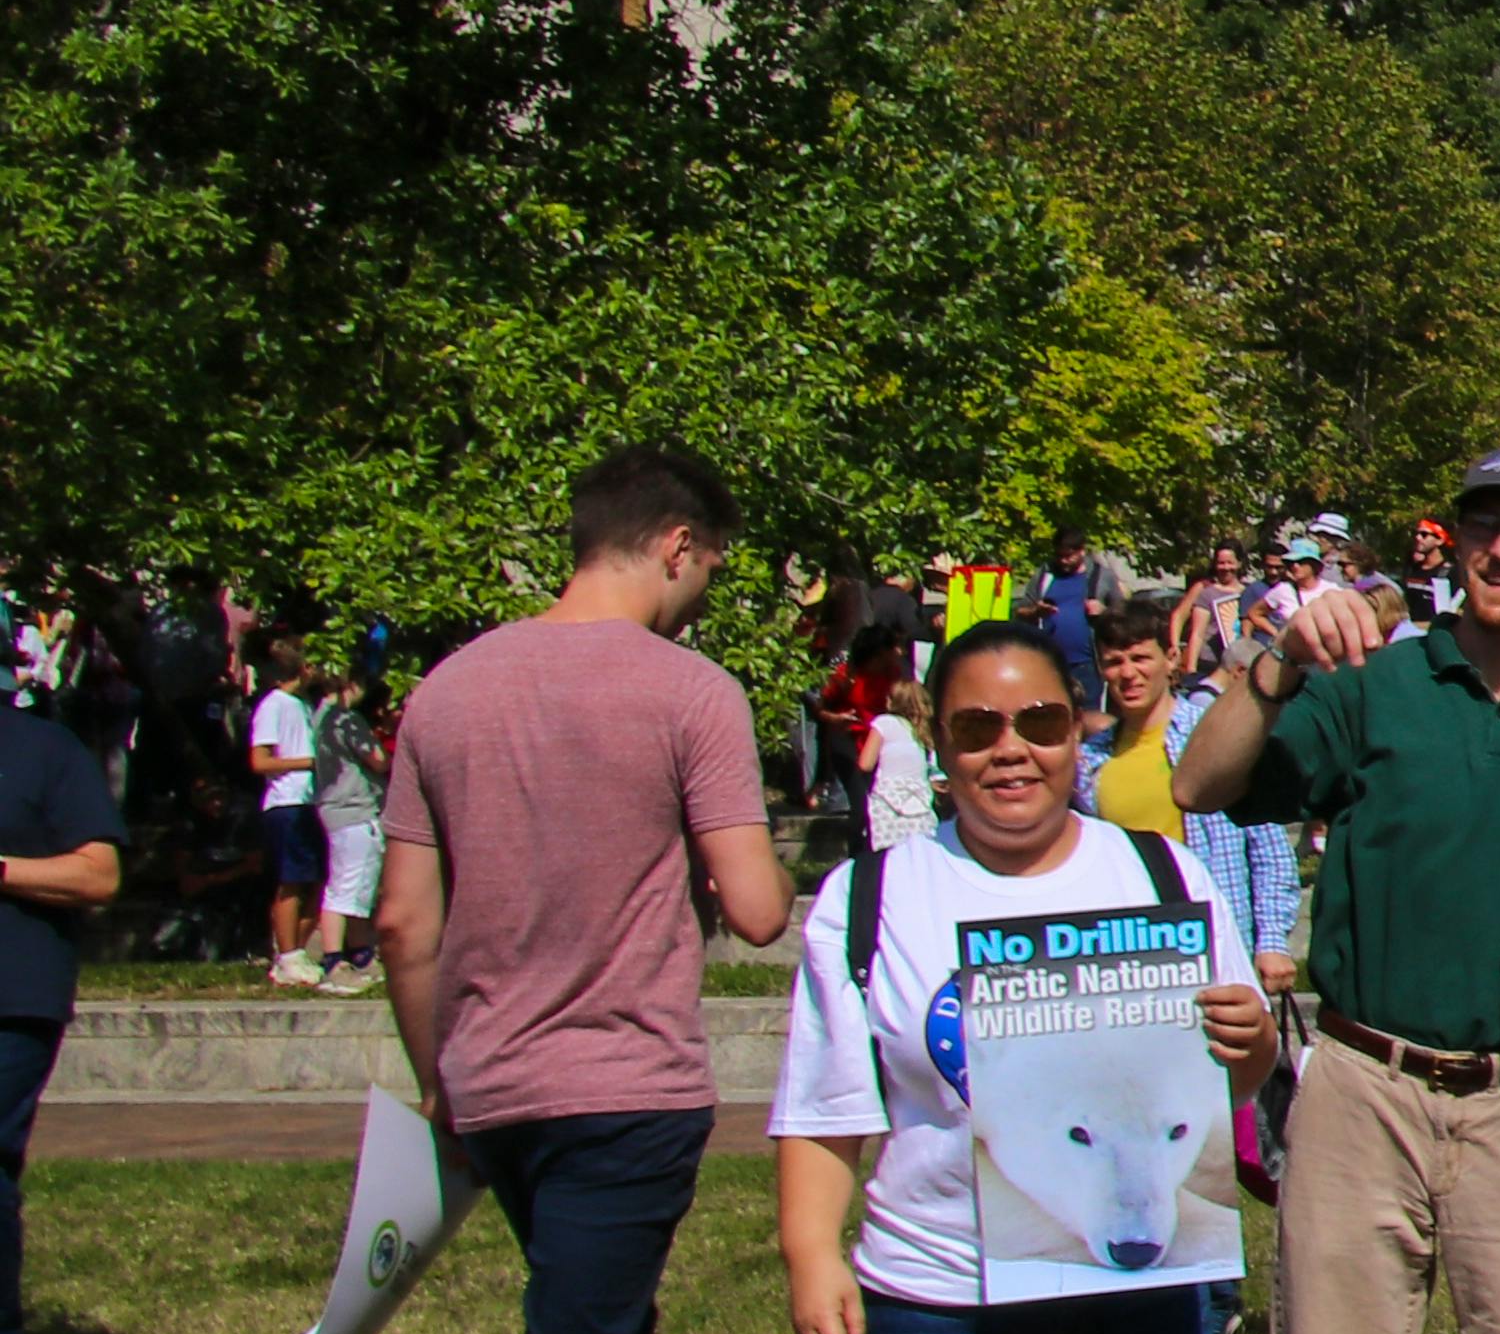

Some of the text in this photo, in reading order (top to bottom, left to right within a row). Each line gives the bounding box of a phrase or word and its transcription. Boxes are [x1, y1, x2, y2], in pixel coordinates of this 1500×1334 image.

[967, 916, 1208, 966] No Drilling
[970, 954, 1210, 1005] Arctic National
[970, 999, 1095, 1039] Wildlife
[1104, 994, 1204, 1030] Refug
